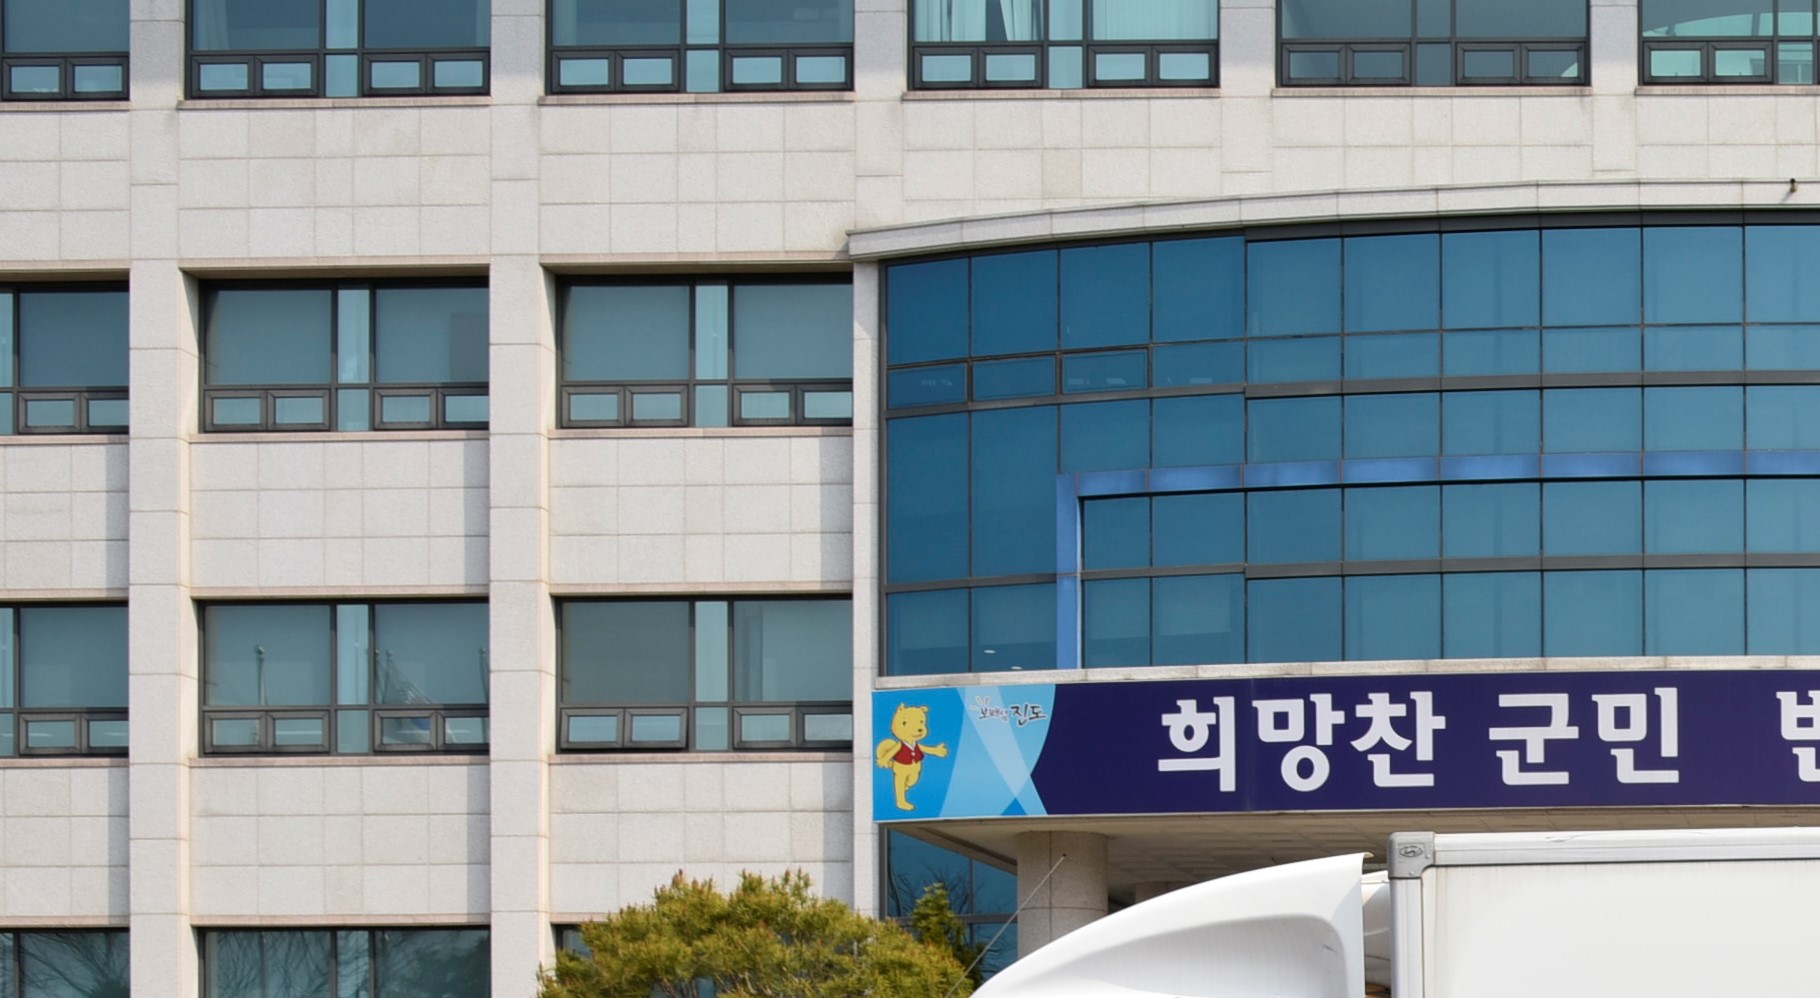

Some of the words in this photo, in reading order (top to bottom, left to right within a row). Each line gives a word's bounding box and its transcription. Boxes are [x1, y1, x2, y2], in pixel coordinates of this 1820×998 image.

[1010, 703, 1048, 726] 진도
[1157, 690, 1447, 794] 희망찬
[1488, 686, 1681, 787] 군민
